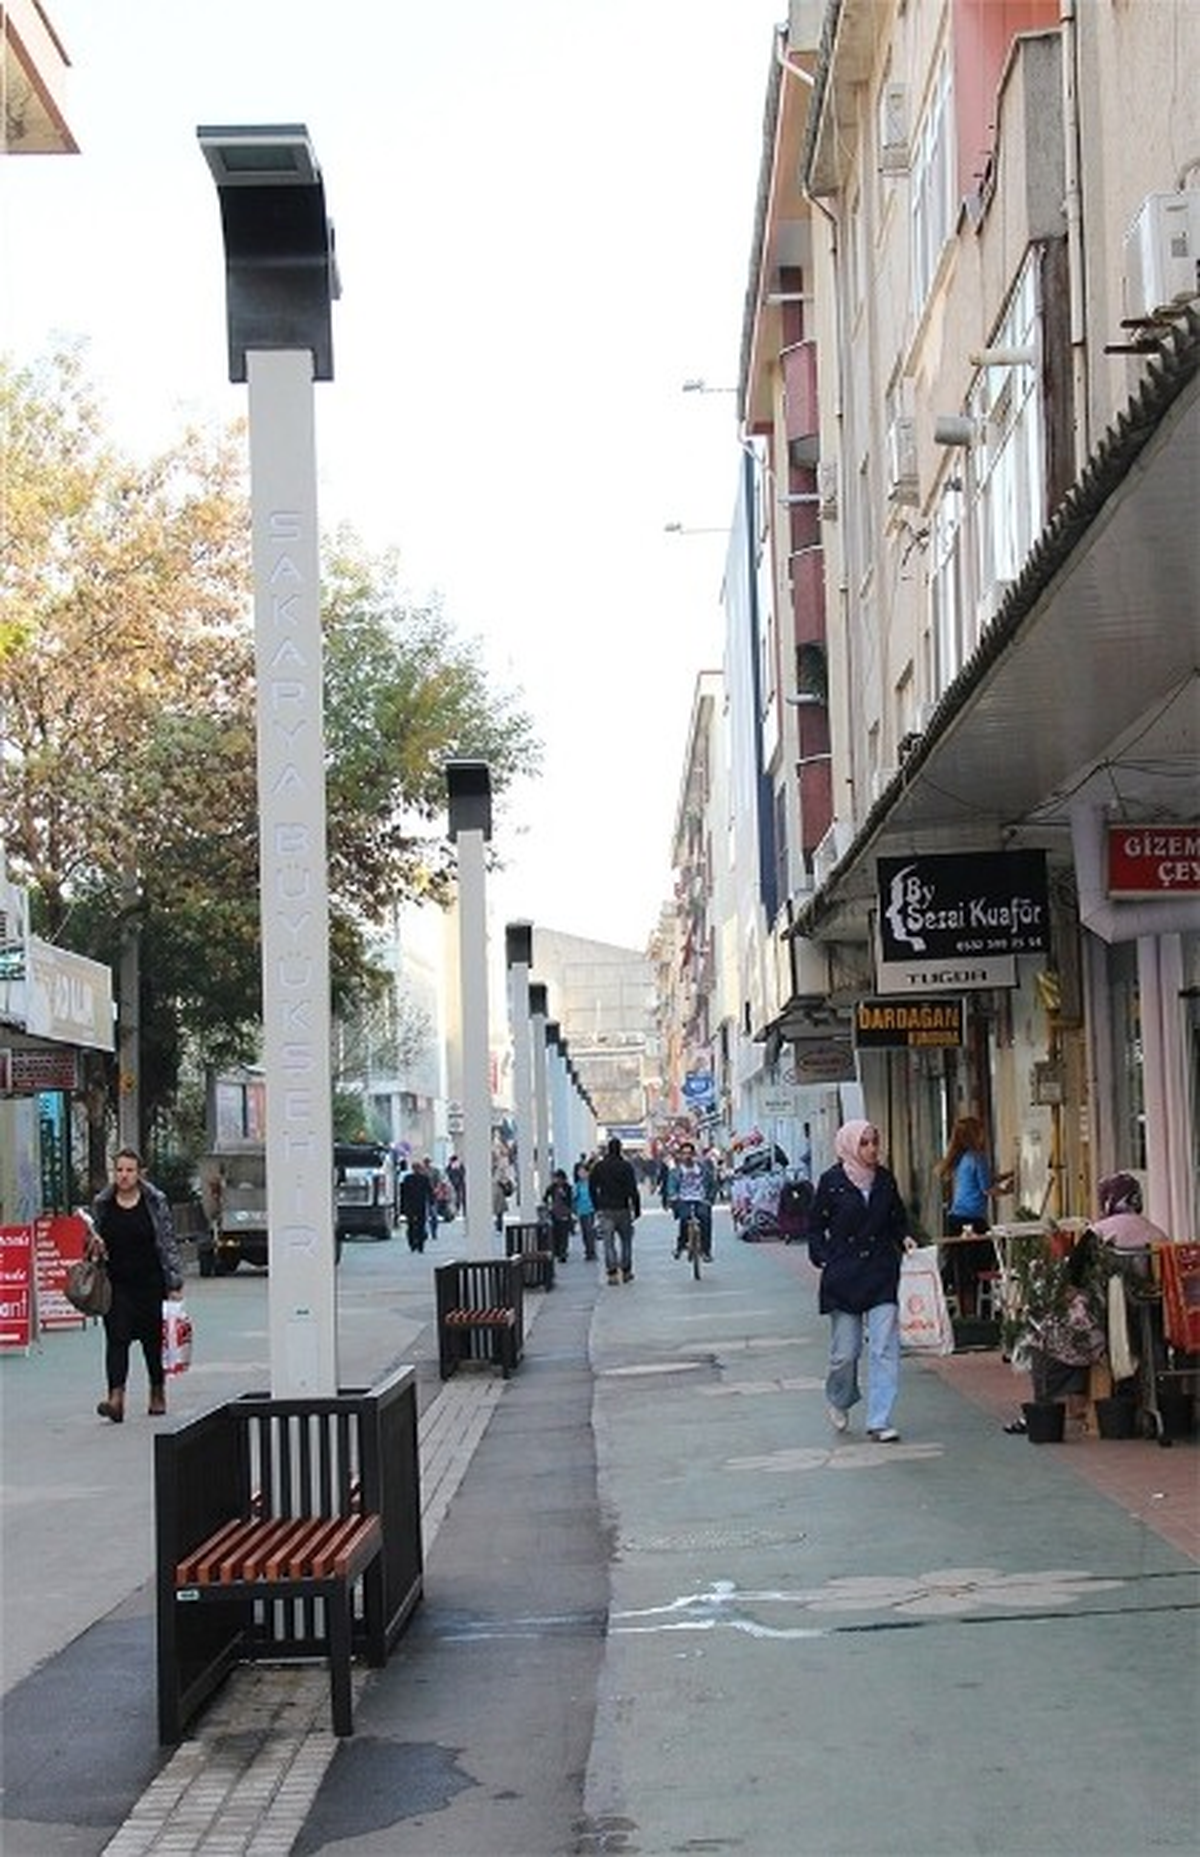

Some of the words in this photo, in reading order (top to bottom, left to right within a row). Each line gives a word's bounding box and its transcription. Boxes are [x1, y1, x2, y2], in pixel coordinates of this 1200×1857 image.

[269, 509, 307, 795] SAKARYA
[1124, 831, 1200, 857] GİZEM
[906, 876, 936, 909] By
[906, 901, 965, 932] Sezai
